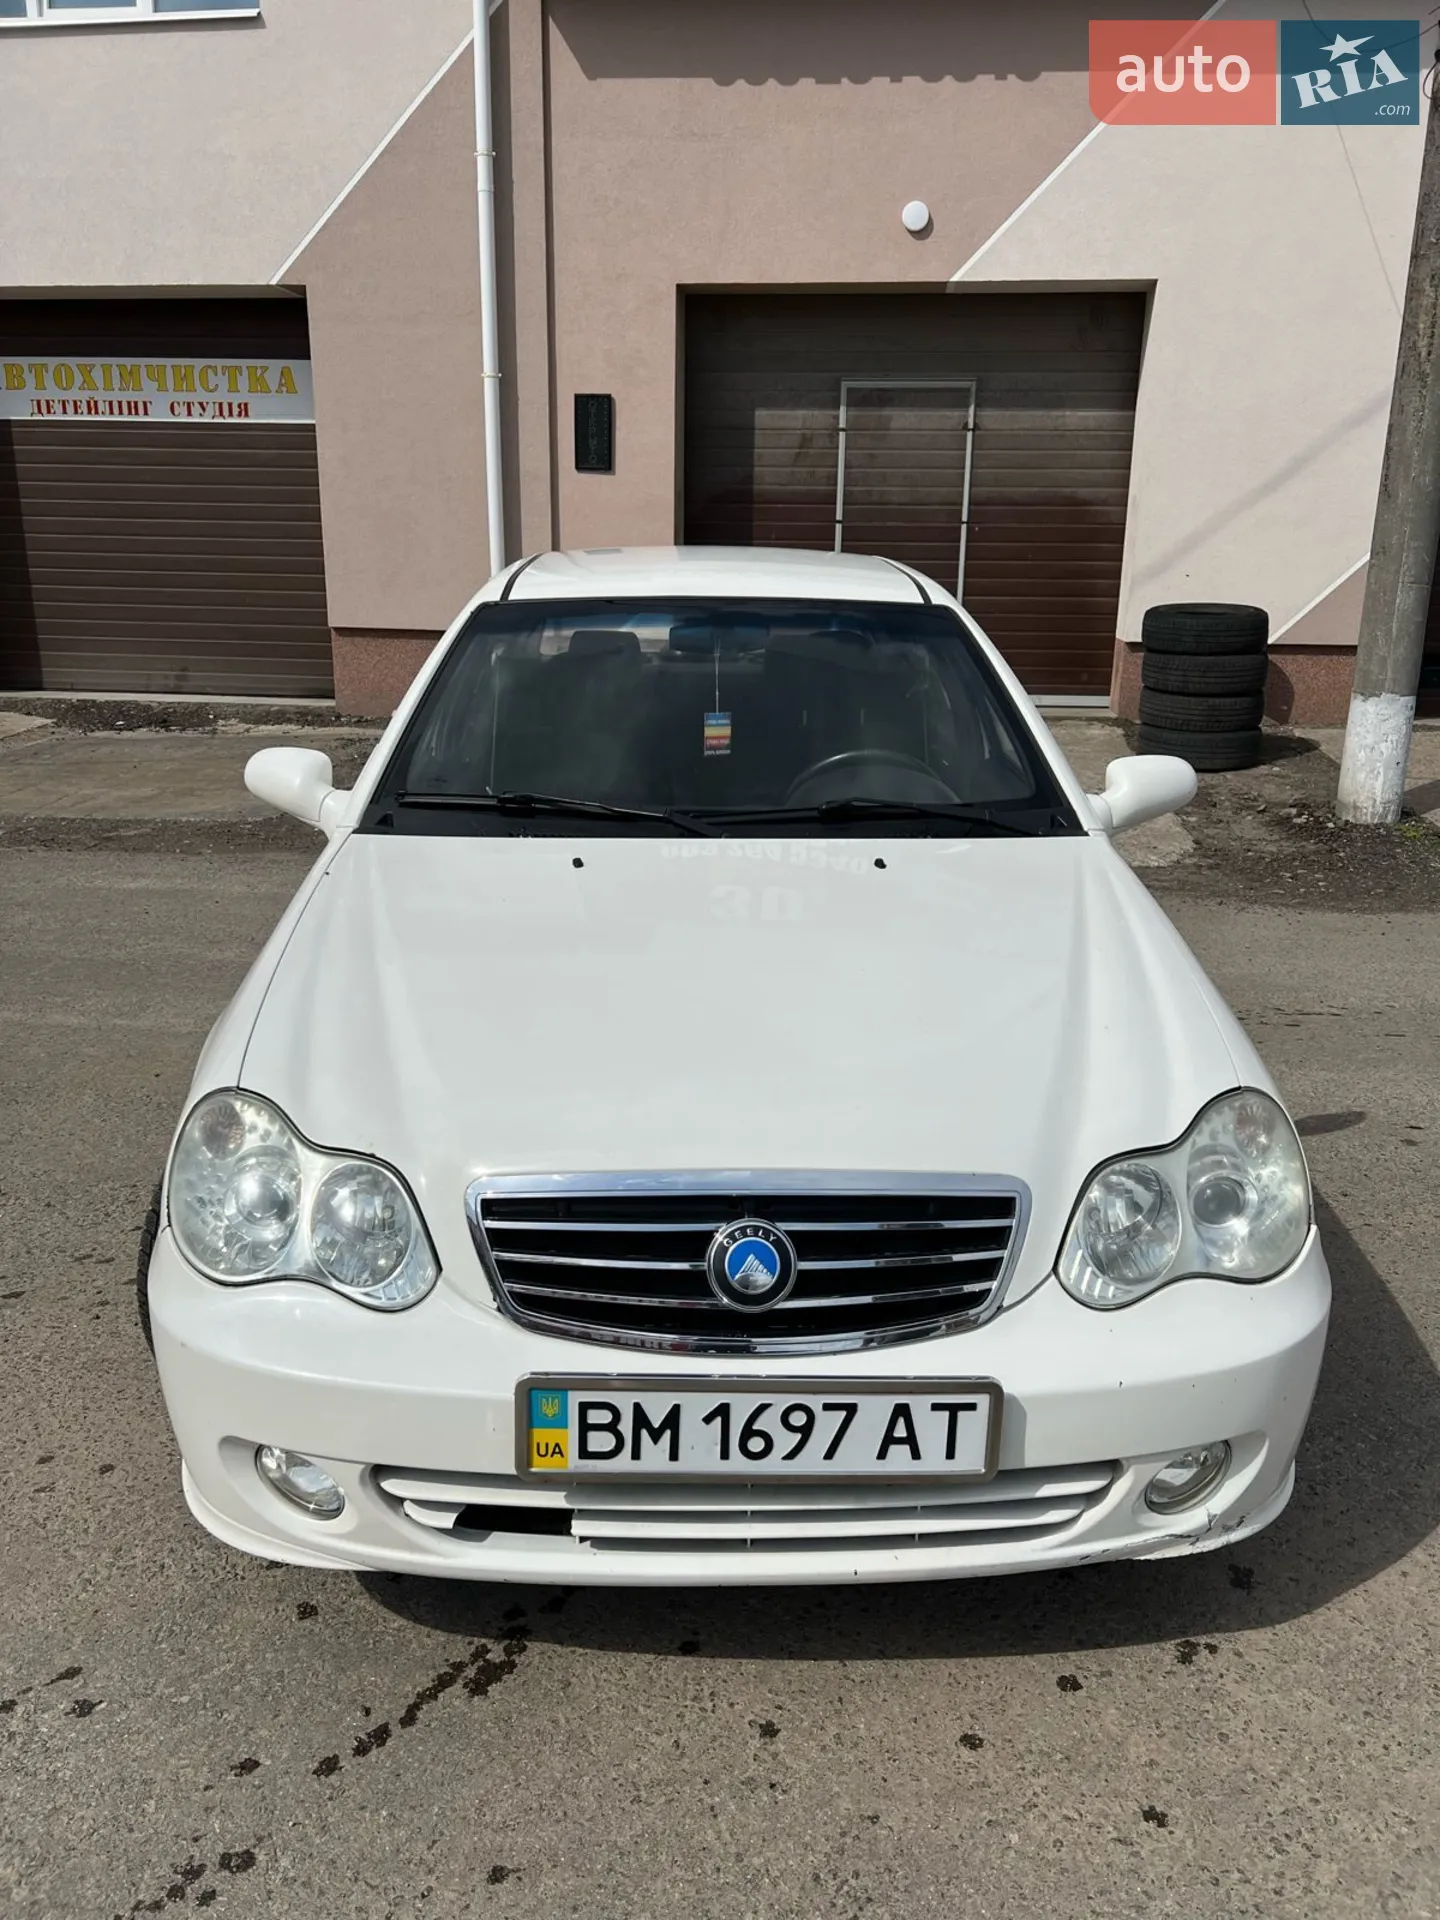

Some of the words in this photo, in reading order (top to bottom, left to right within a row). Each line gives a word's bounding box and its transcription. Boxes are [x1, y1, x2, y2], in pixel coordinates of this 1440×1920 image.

[0, 362, 298, 394] ВТОХІМЧИСТКА
[30, 396, 152, 418] ДЕТЕЙЛІНГ
[169, 401, 250, 419] СТУДІЯ
[723, 1227, 777, 1248] GEELY
[577, 1401, 681, 1461] BM
[701, 1402, 858, 1461] 1697
[876, 1402, 978, 1460] AT
[536, 1442, 565, 1459] UA
